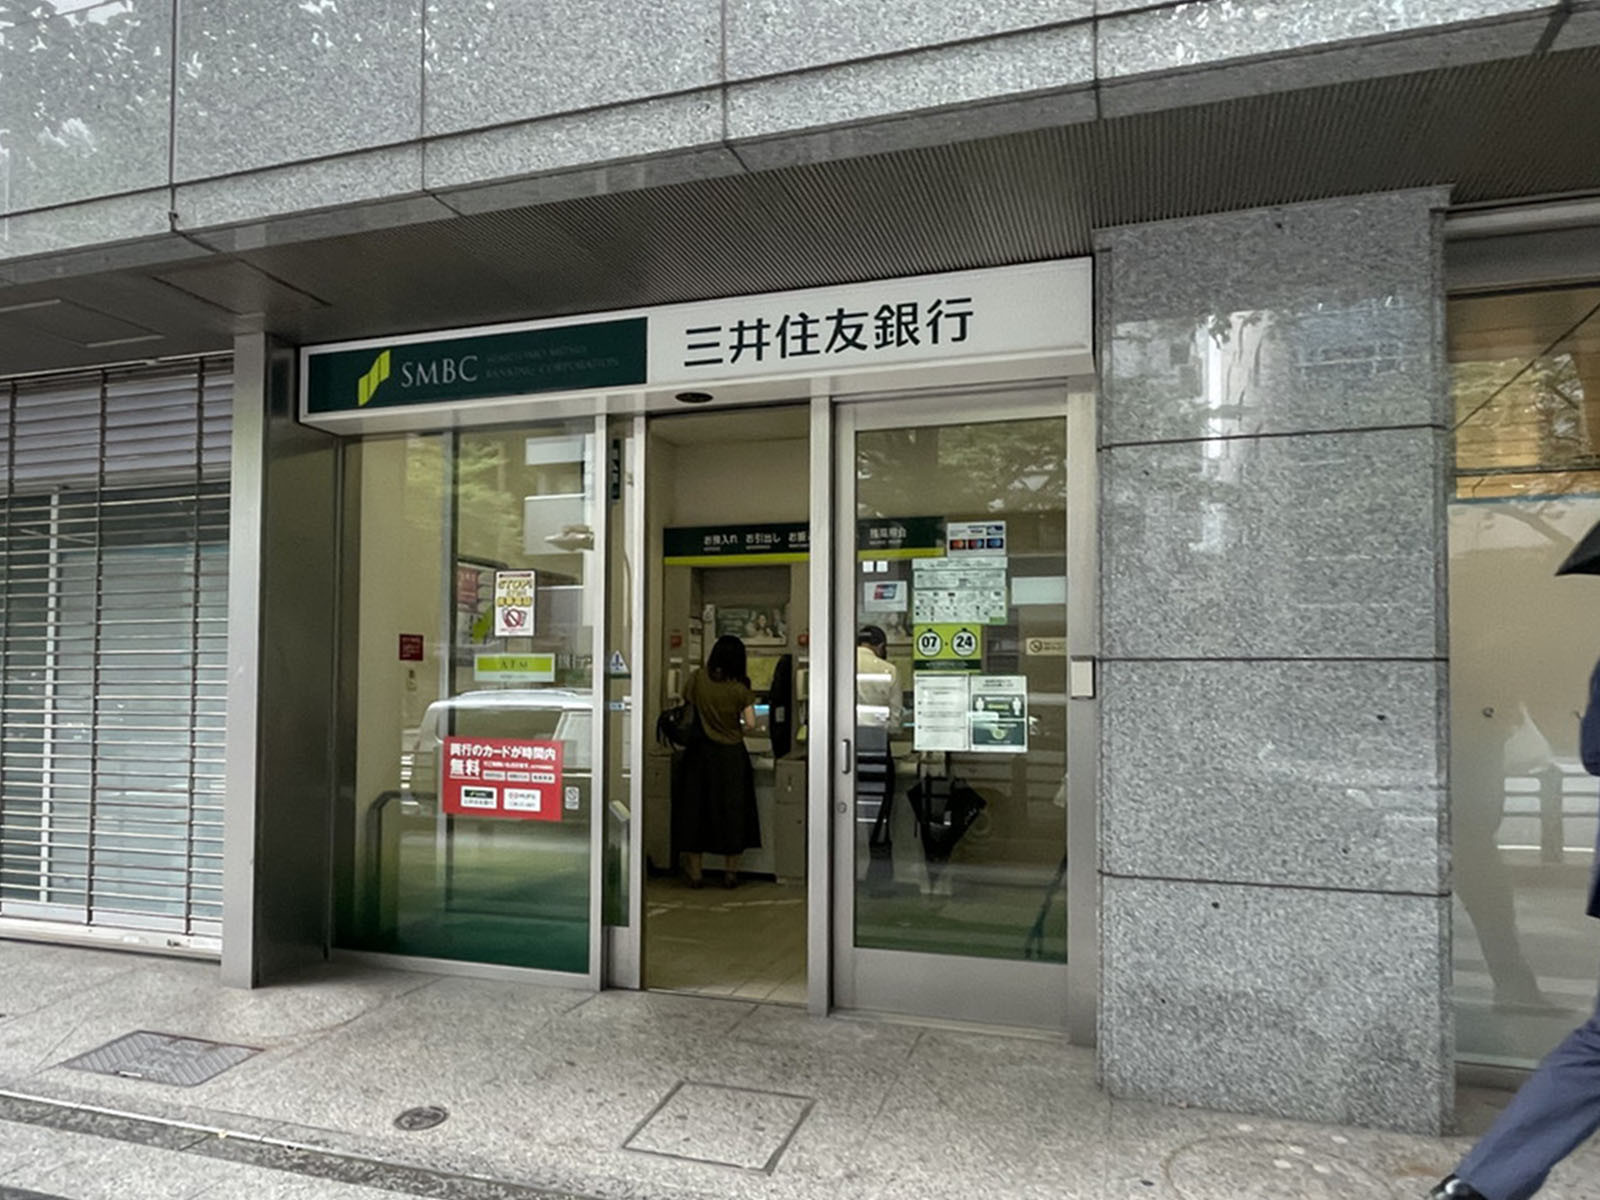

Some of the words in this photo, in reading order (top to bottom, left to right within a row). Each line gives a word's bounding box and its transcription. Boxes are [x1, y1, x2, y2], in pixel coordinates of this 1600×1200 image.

[684, 296, 975, 367] 三井住友銀行
[400, 355, 478, 388] SMBC
[921, 635, 938, 649] 07
[955, 635, 973, 649] 24
[450, 758, 480, 777] 無料
